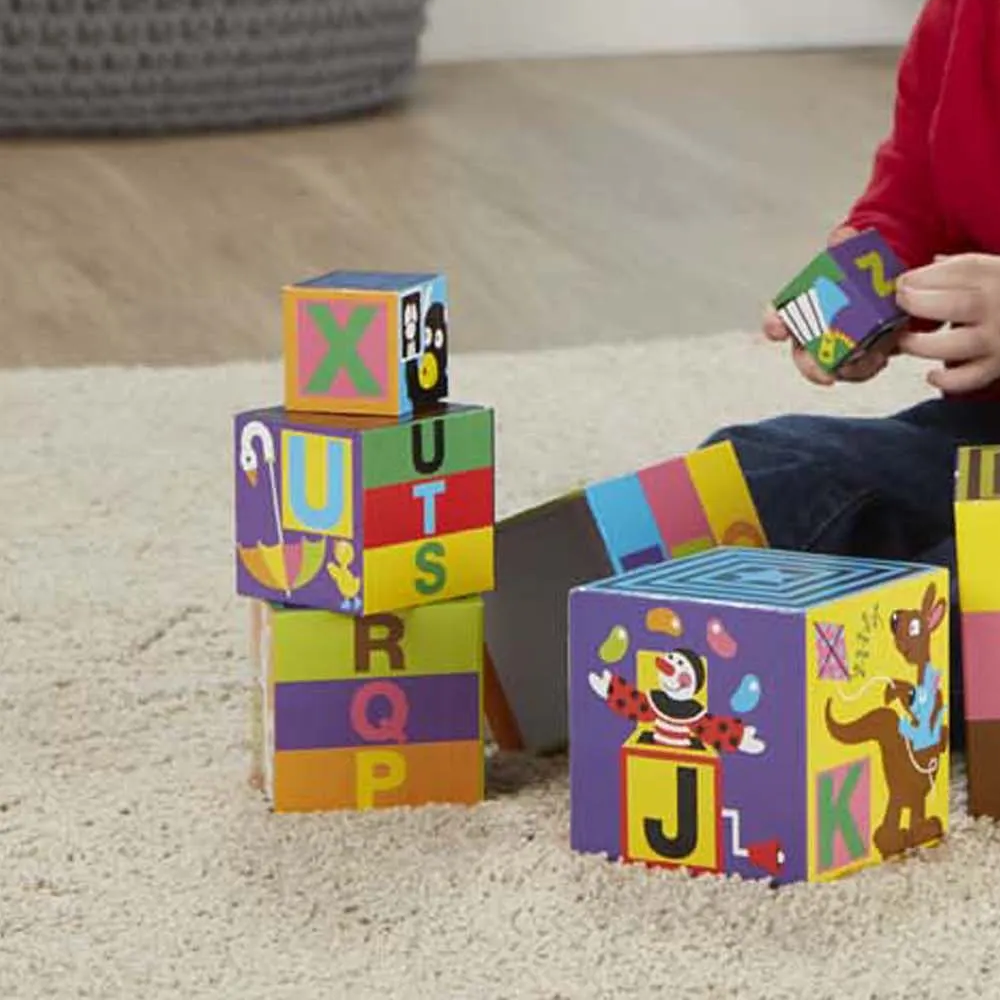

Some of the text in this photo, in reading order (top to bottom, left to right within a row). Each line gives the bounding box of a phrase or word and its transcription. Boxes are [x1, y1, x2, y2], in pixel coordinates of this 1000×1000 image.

[306, 303, 381, 395] X
[412, 419, 445, 474] U
[289, 435, 343, 530] U
[412, 480, 446, 535] T
[415, 542, 446, 595] S
[354, 613, 406, 673] R
[350, 681, 409, 744] Q
[356, 751, 407, 811] P
[643, 767, 698, 860] J
[816, 764, 865, 868] K
